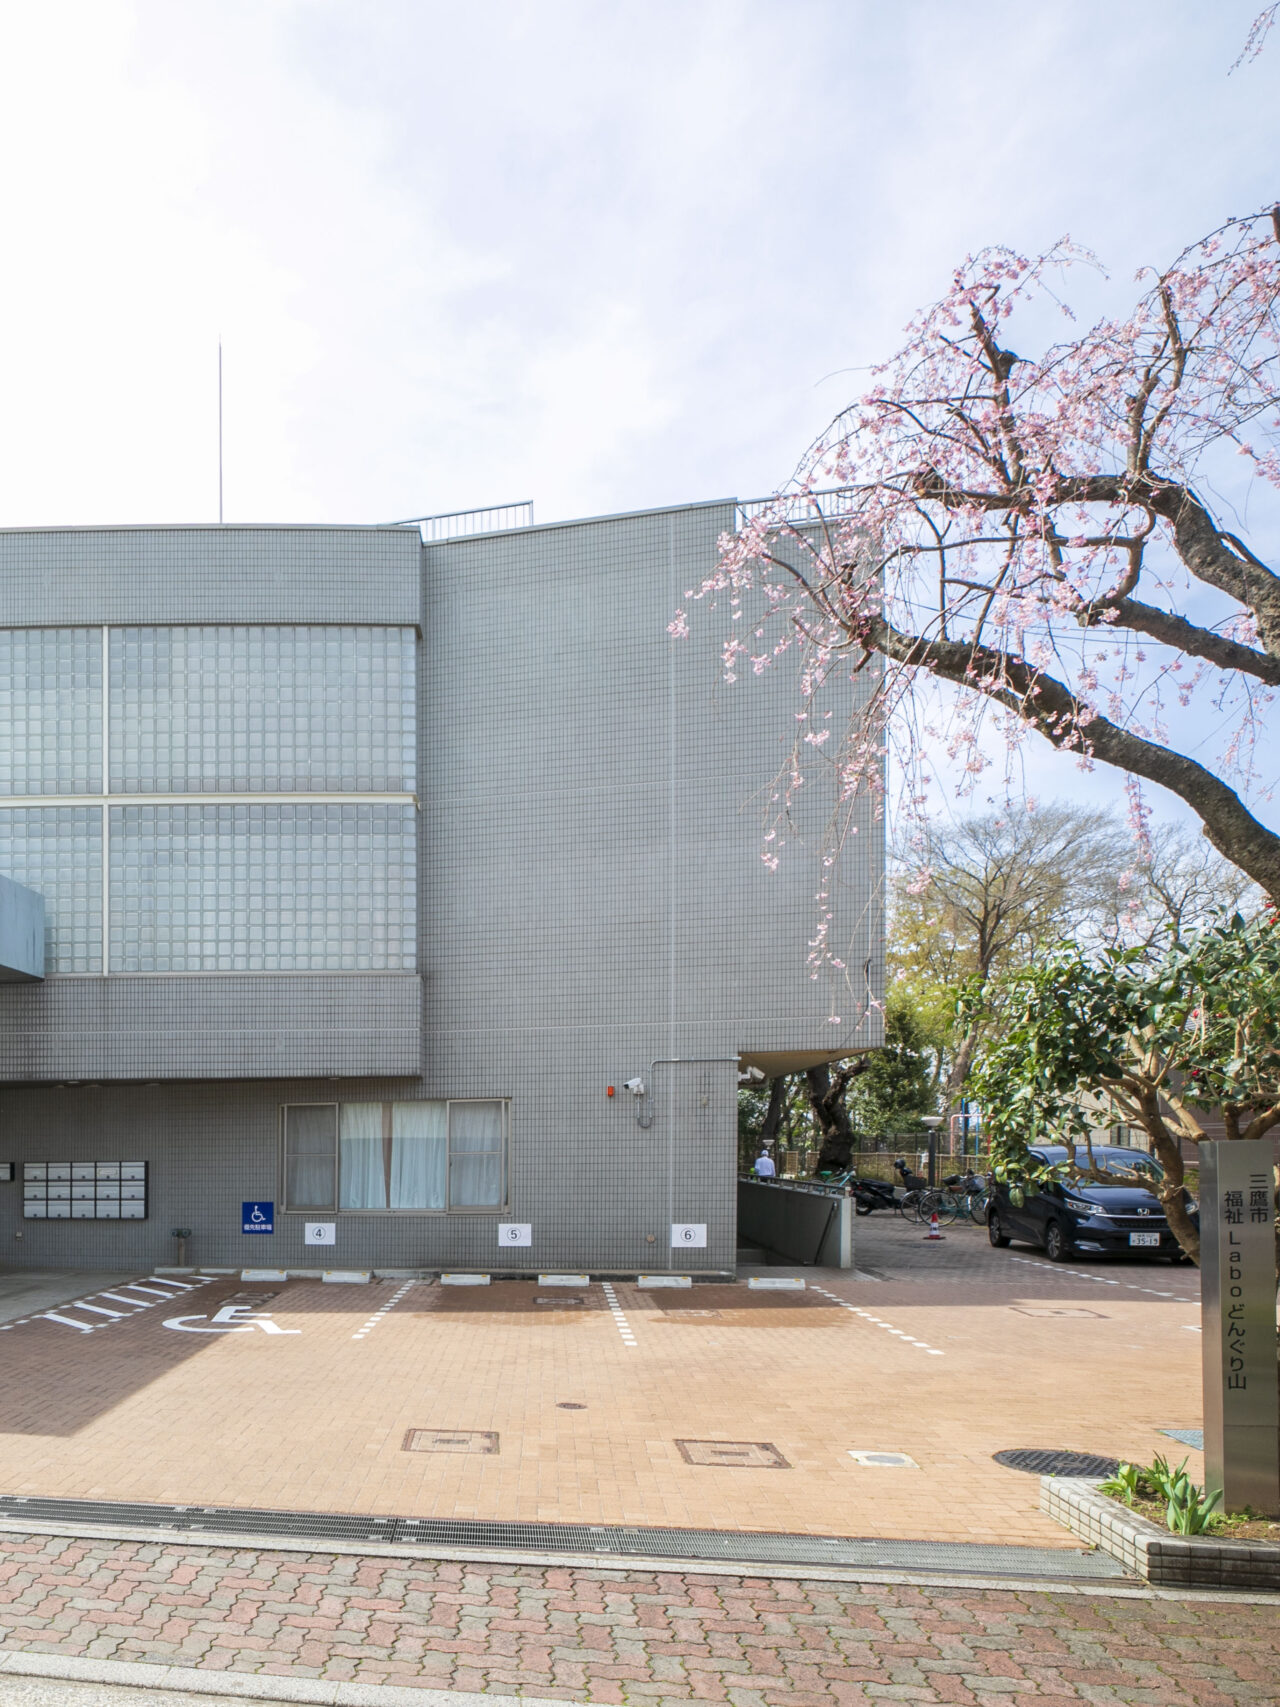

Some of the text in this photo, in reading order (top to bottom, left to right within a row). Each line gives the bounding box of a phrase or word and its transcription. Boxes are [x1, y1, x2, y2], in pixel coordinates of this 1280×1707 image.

[1248, 1174, 1269, 1224] 三鷹市
[1224, 1190, 1247, 1390] 福祉Laboどんぐり山
